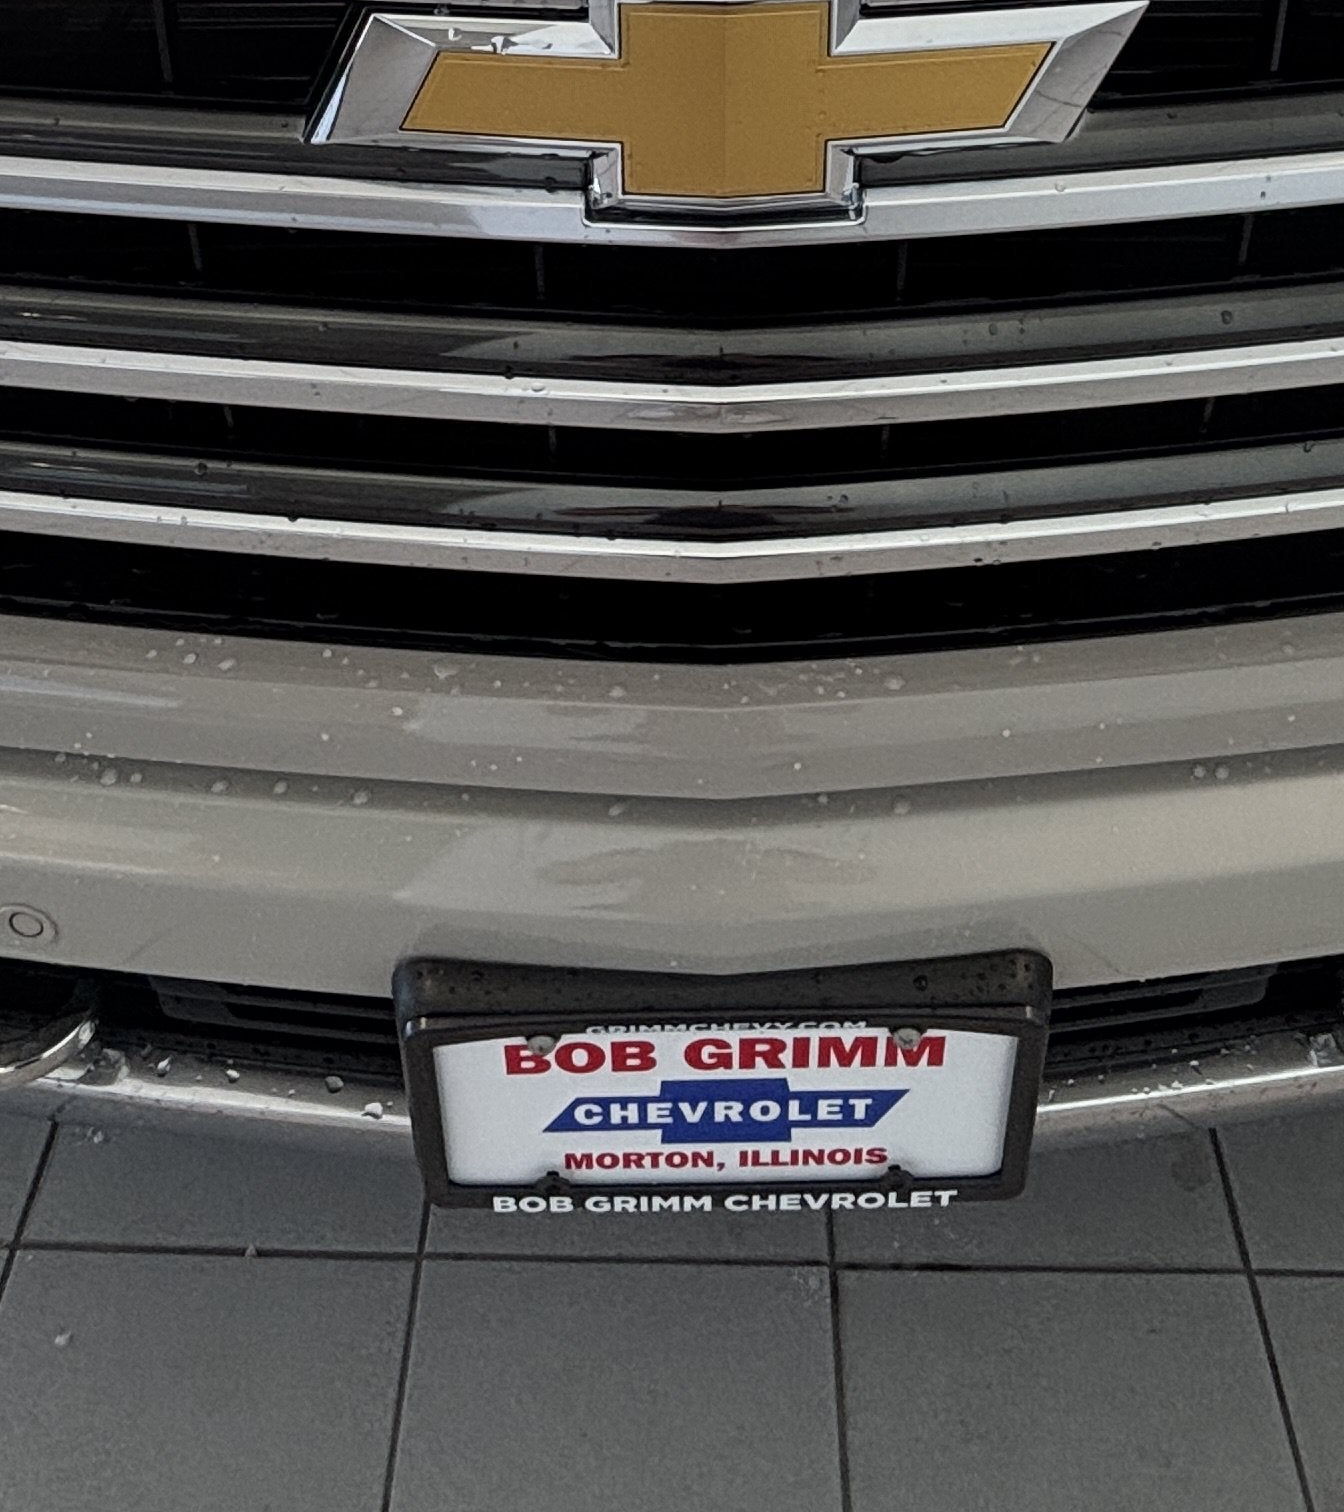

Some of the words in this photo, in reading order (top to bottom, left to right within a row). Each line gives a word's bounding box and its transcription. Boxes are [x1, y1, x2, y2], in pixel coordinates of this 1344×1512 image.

[504, 1040, 658, 1076] BOB
[683, 1036, 947, 1071] GRIMM
[573, 1097, 874, 1126] CHEVROLET
[564, 1150, 725, 1172] MORTON,
[738, 1147, 889, 1168] ILLINOIS
[492, 1195, 574, 1213] BOB
[584, 1194, 713, 1213] GRIMM
[724, 1189, 959, 1212] CHEVROLET
